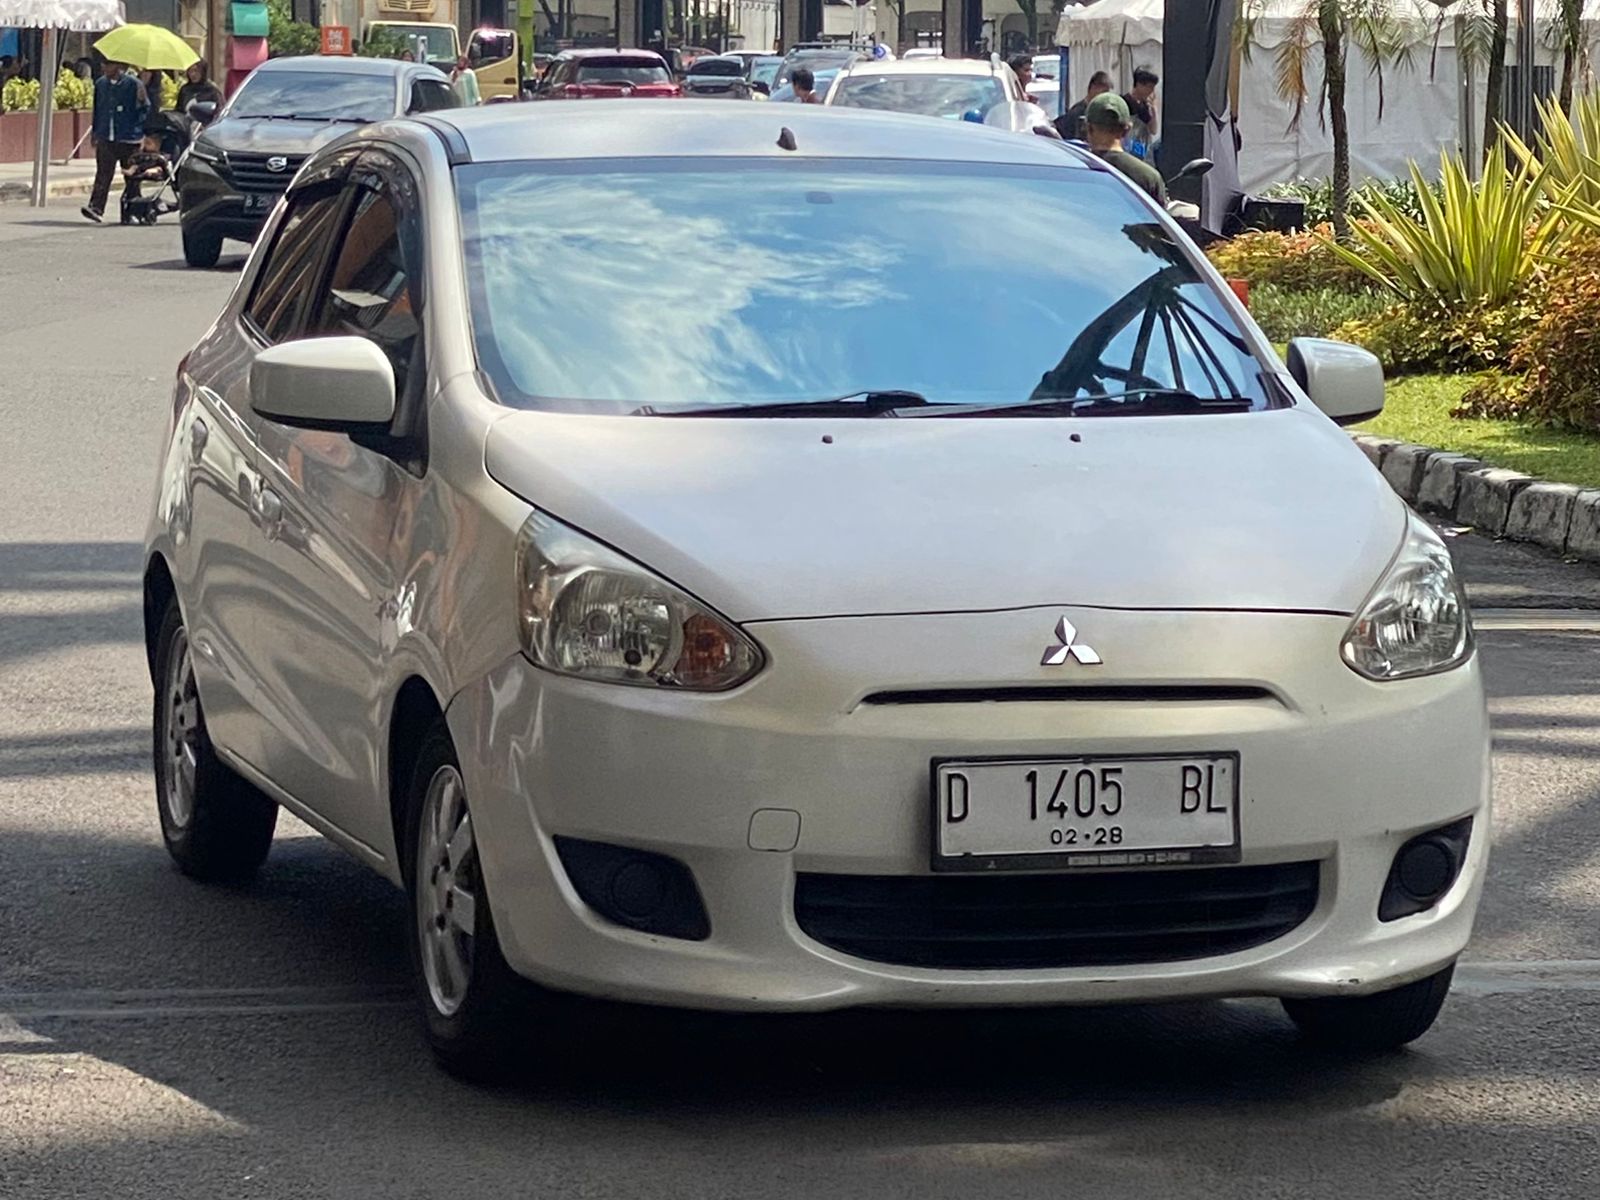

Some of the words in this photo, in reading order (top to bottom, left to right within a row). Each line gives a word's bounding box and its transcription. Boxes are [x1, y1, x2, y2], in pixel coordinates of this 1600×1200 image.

[947, 773, 969, 823] D
[1025, 767, 1122, 820] 1405
[1181, 765, 1227, 814] BL
